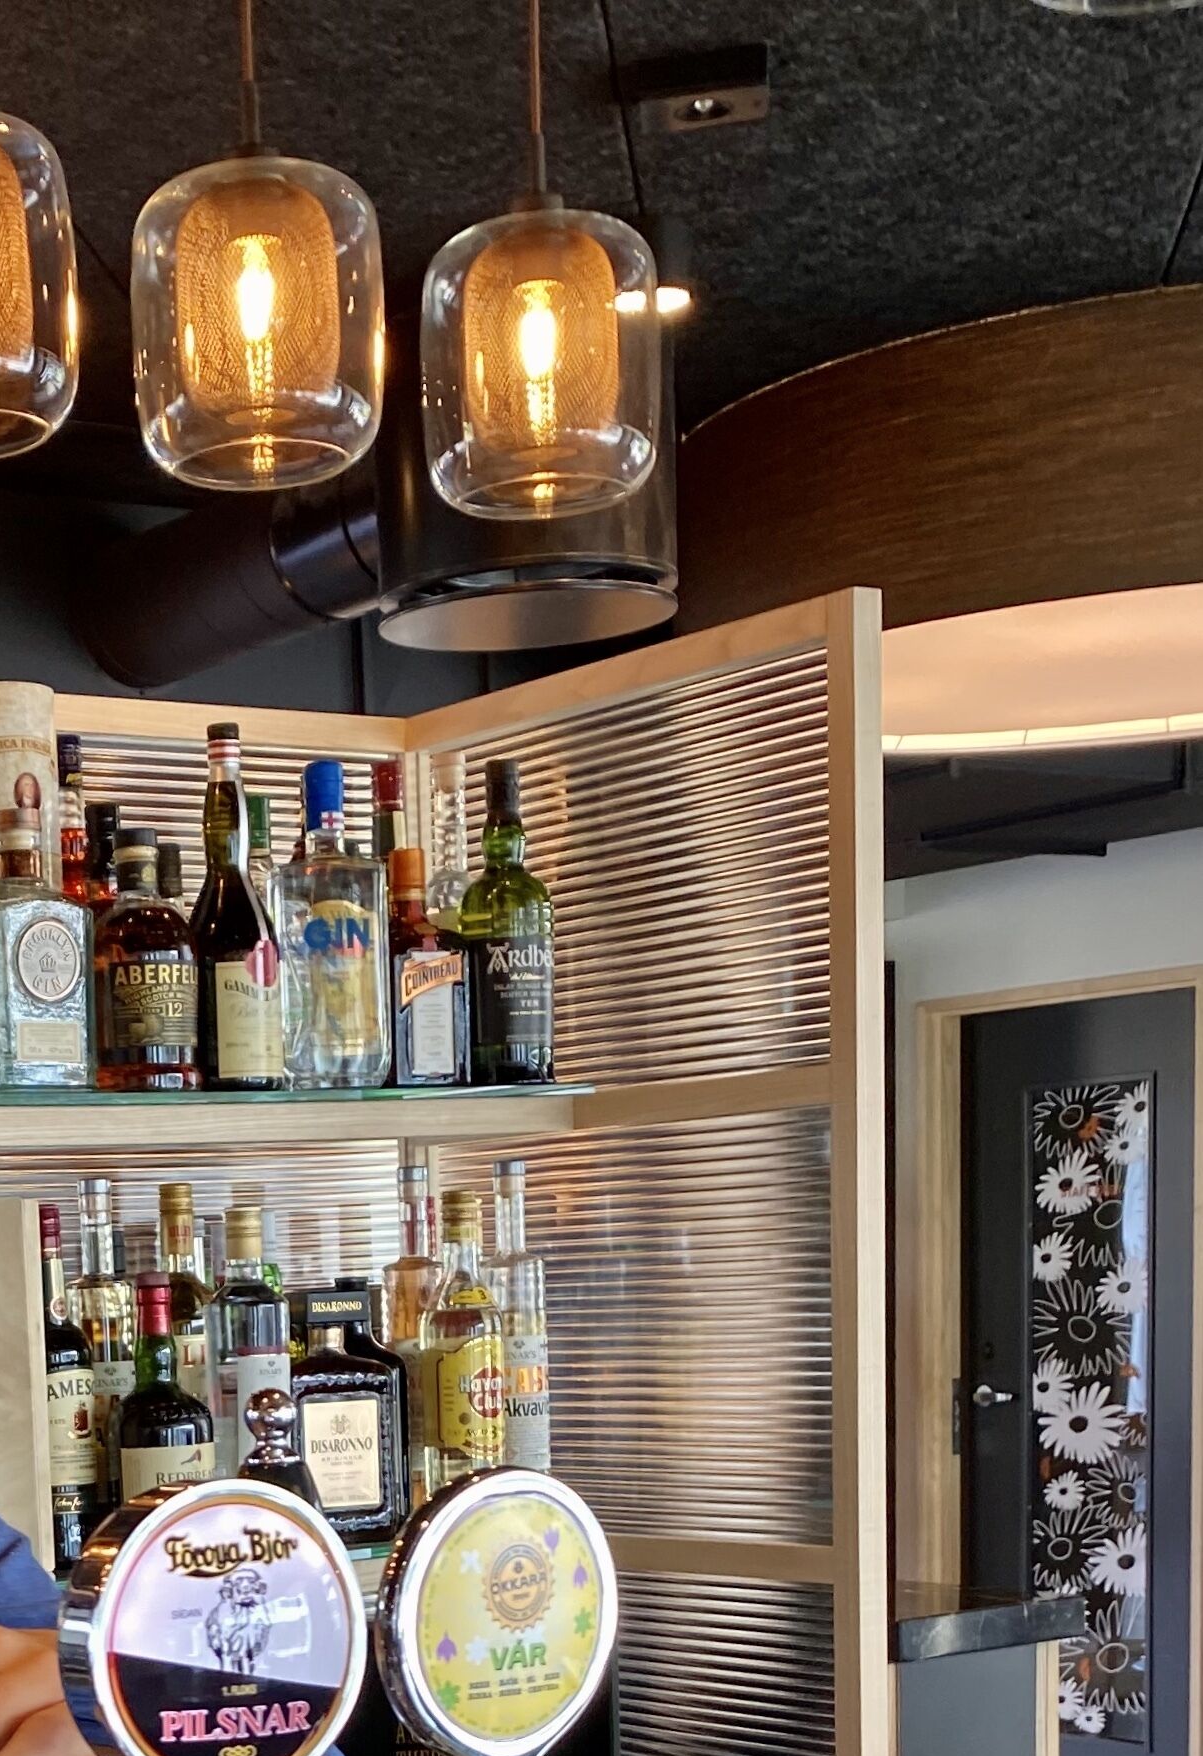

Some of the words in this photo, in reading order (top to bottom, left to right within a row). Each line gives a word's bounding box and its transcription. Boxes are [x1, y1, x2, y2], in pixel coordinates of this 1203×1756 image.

[303, 917, 370, 949] GIN
[32, 973, 62, 994] GIN
[114, 963, 199, 985] ABERFEL
[404, 960, 459, 997] COINTREAU
[166, 1001, 184, 1018] 12
[311, 1302, 363, 1313] DISARONNO
[459, 1374, 503, 1394] Hava
[503, 1365, 548, 1396] CAS
[310, 1436, 374, 1455] DISARONNO
[489, 1638, 547, 1671] VÁR
[158, 1700, 312, 1742] PILSNAR
